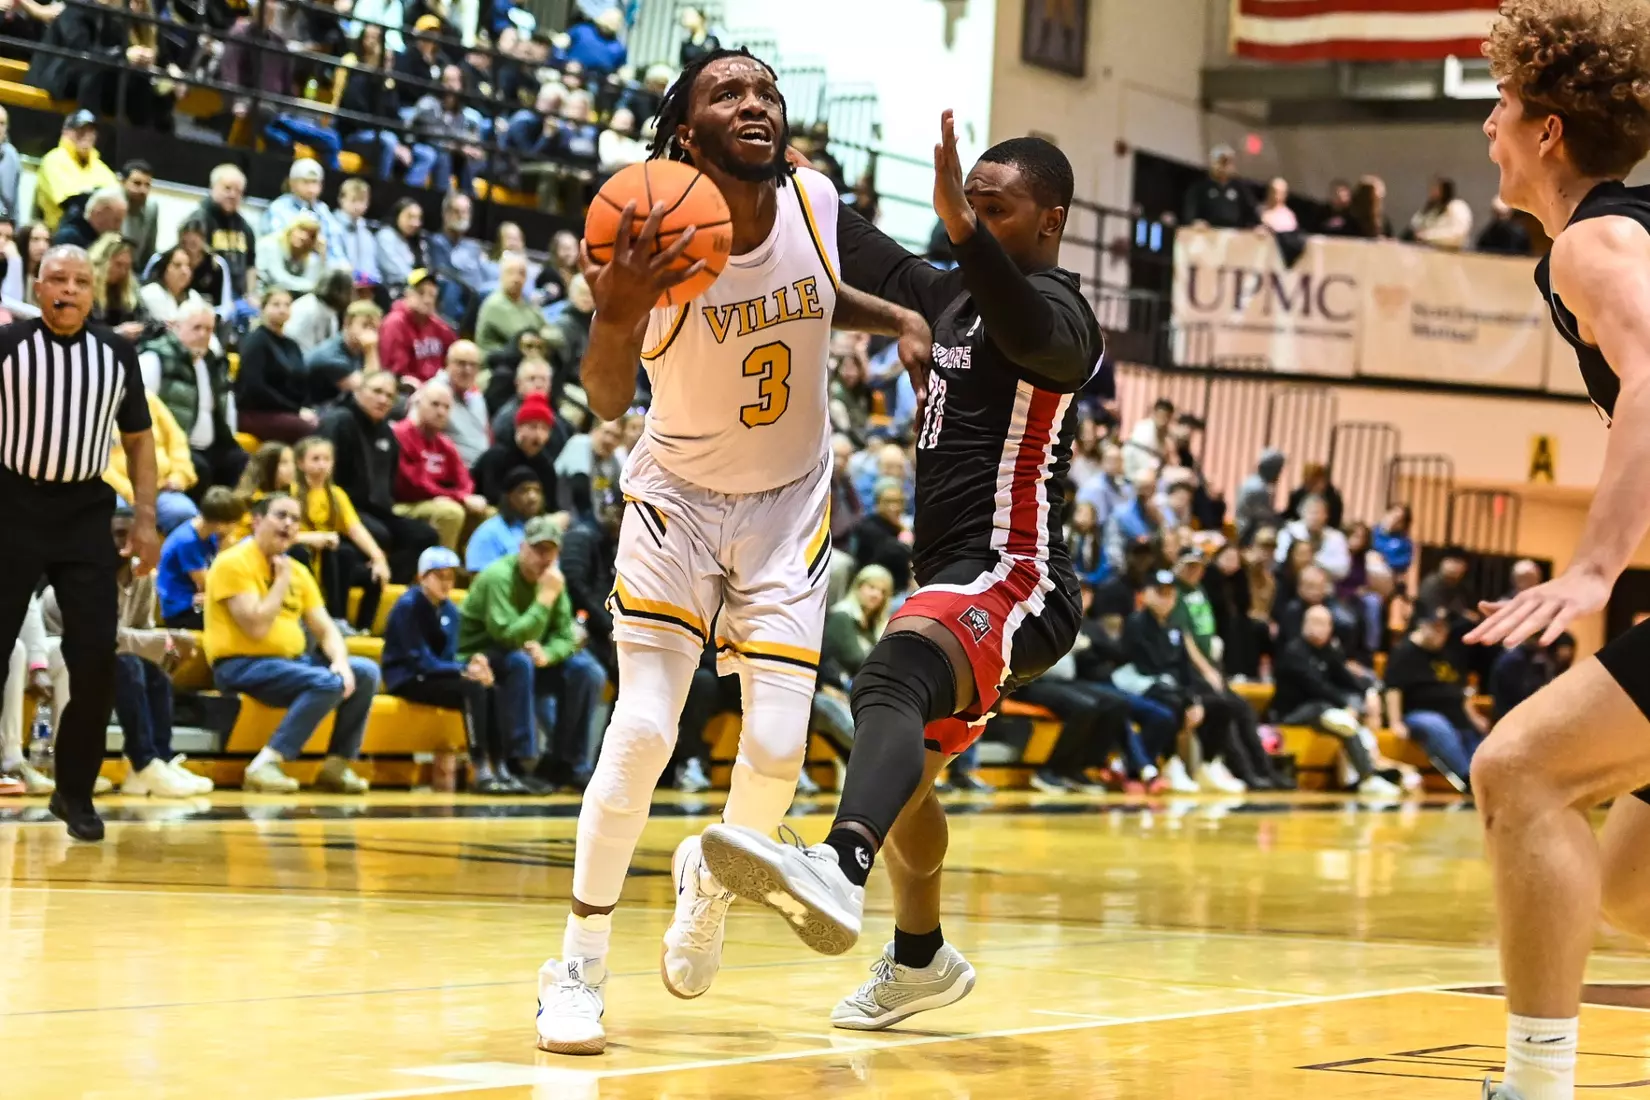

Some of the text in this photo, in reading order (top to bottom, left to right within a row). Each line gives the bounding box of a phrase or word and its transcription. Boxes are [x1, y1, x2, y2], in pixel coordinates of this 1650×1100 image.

[702, 275, 824, 344] VILLE
[1187, 262, 1357, 322] UPMC
[740, 339, 792, 429] 3
[1529, 436, 1555, 482] A
